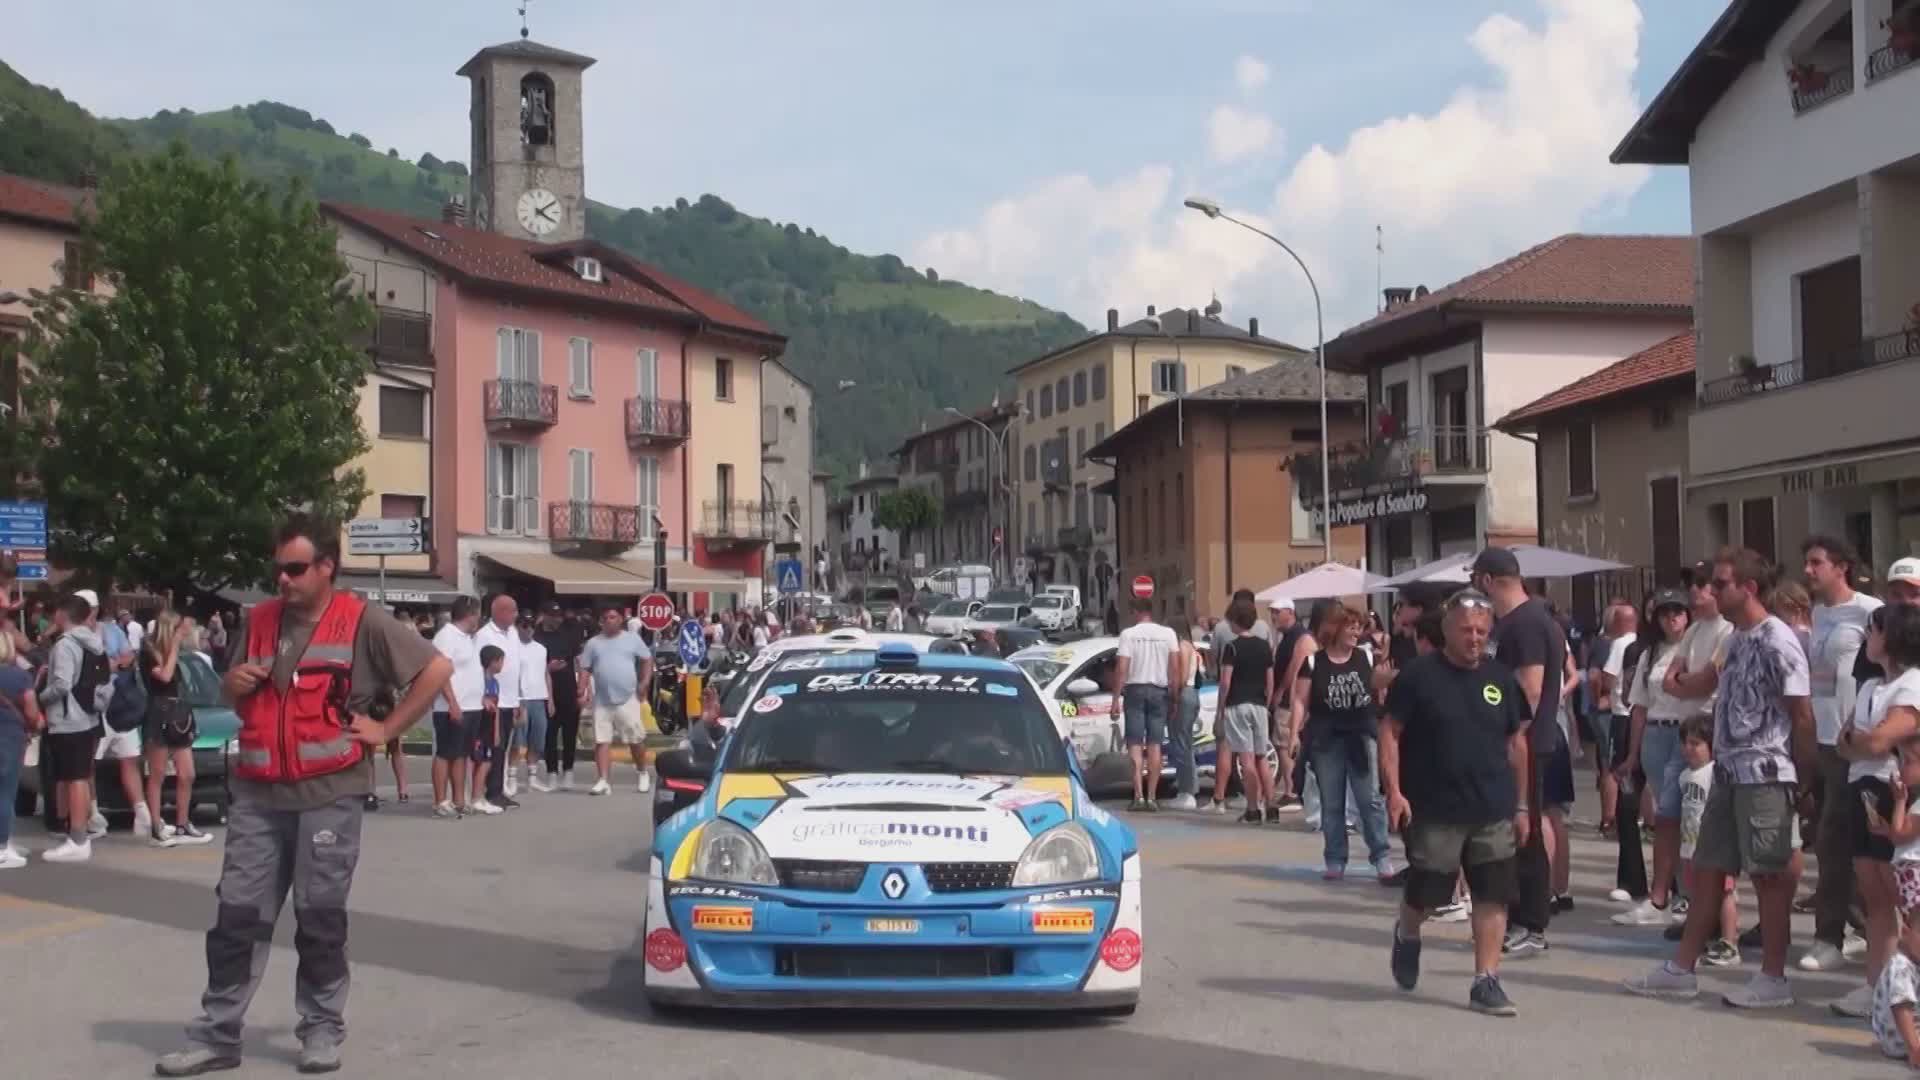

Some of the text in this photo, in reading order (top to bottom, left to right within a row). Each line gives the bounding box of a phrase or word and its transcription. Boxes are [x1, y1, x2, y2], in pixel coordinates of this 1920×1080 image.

[1376, 495, 1387, 516] di
[1387, 489, 1428, 513] Sondrio
[641, 605, 672, 619] STOP
[951, 675, 979, 688] 4
[693, 908, 752, 926] PIRELLI
[1035, 911, 1093, 929] PIRELLI
